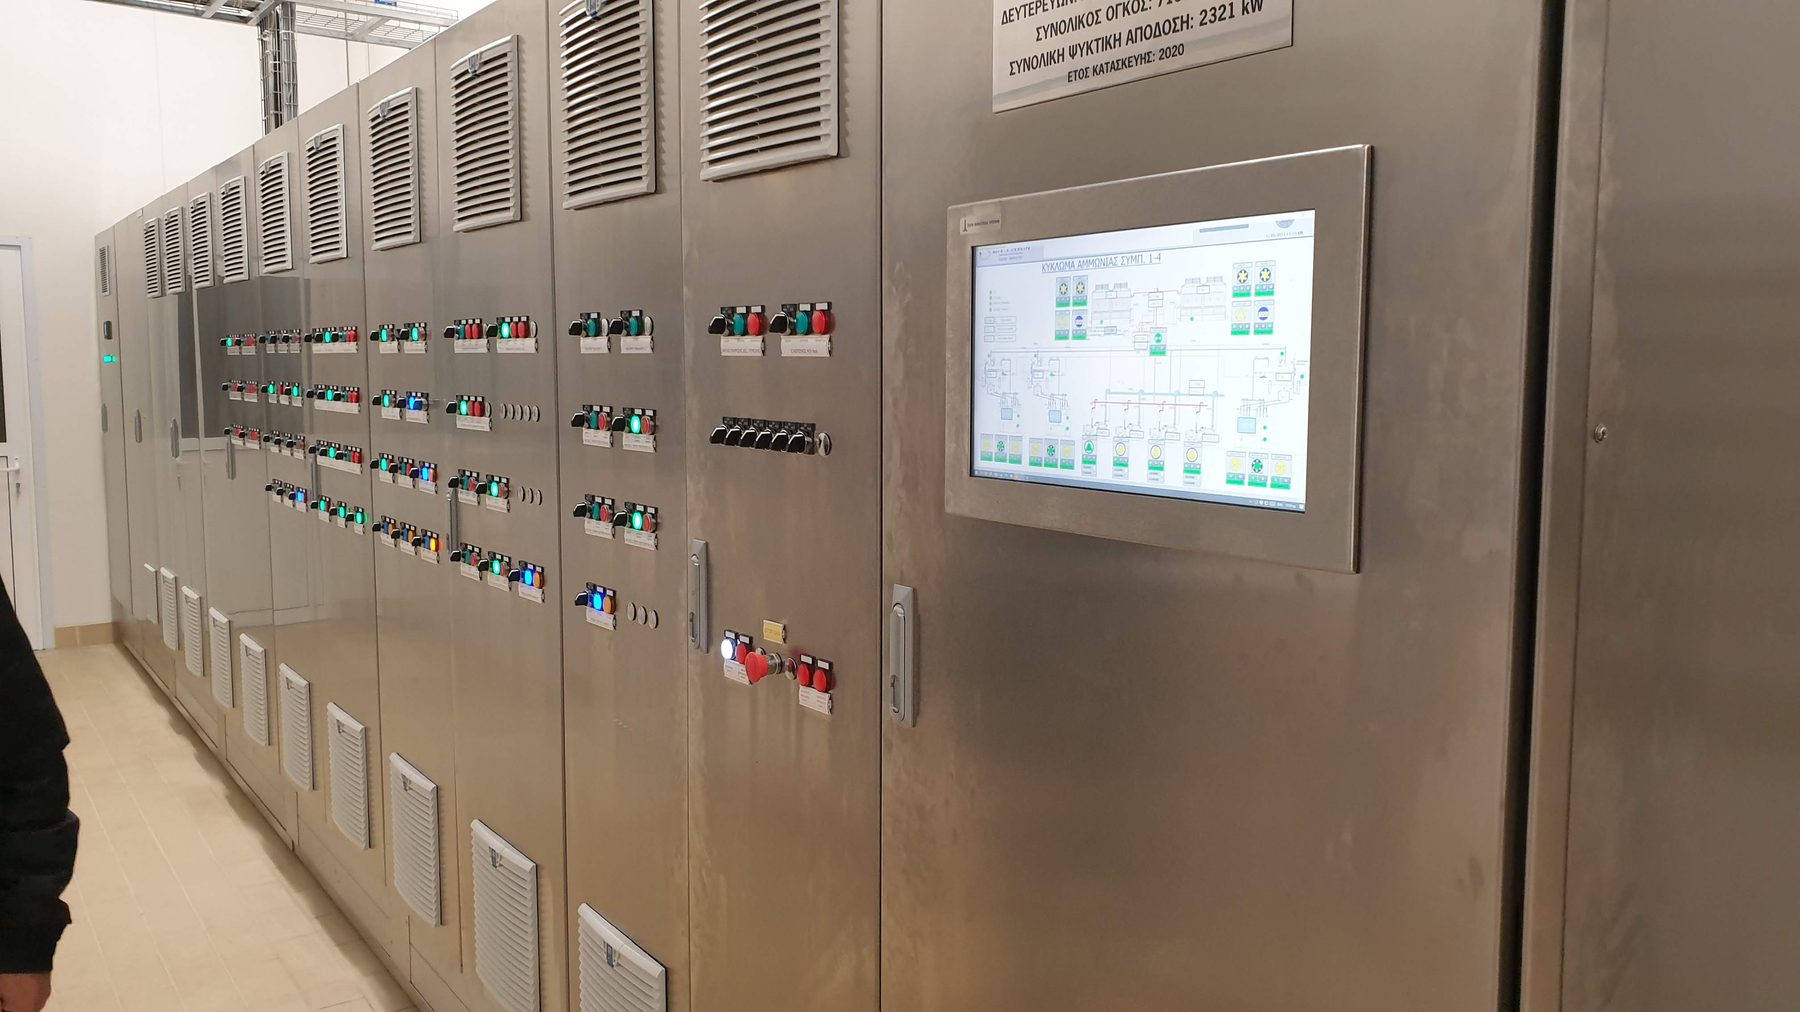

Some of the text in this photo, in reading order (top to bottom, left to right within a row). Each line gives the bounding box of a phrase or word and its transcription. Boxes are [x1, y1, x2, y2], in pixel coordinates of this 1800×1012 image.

[1009, 0, 1264, 76] ΣΥΝΟΛΙΚΗ ΨΥΚΤΙΚΗ ΑΠΟΔΟΣΗ: 2321 kW
[1036, 0, 1152, 42] ΣΥΝΟΛΙΚΟΣ ΟΓΚΟΣ:
[1067, 43, 1185, 83] ΕΤΟΣ ΚΑΤΑΣΚΕΥΗΣ: 2020
